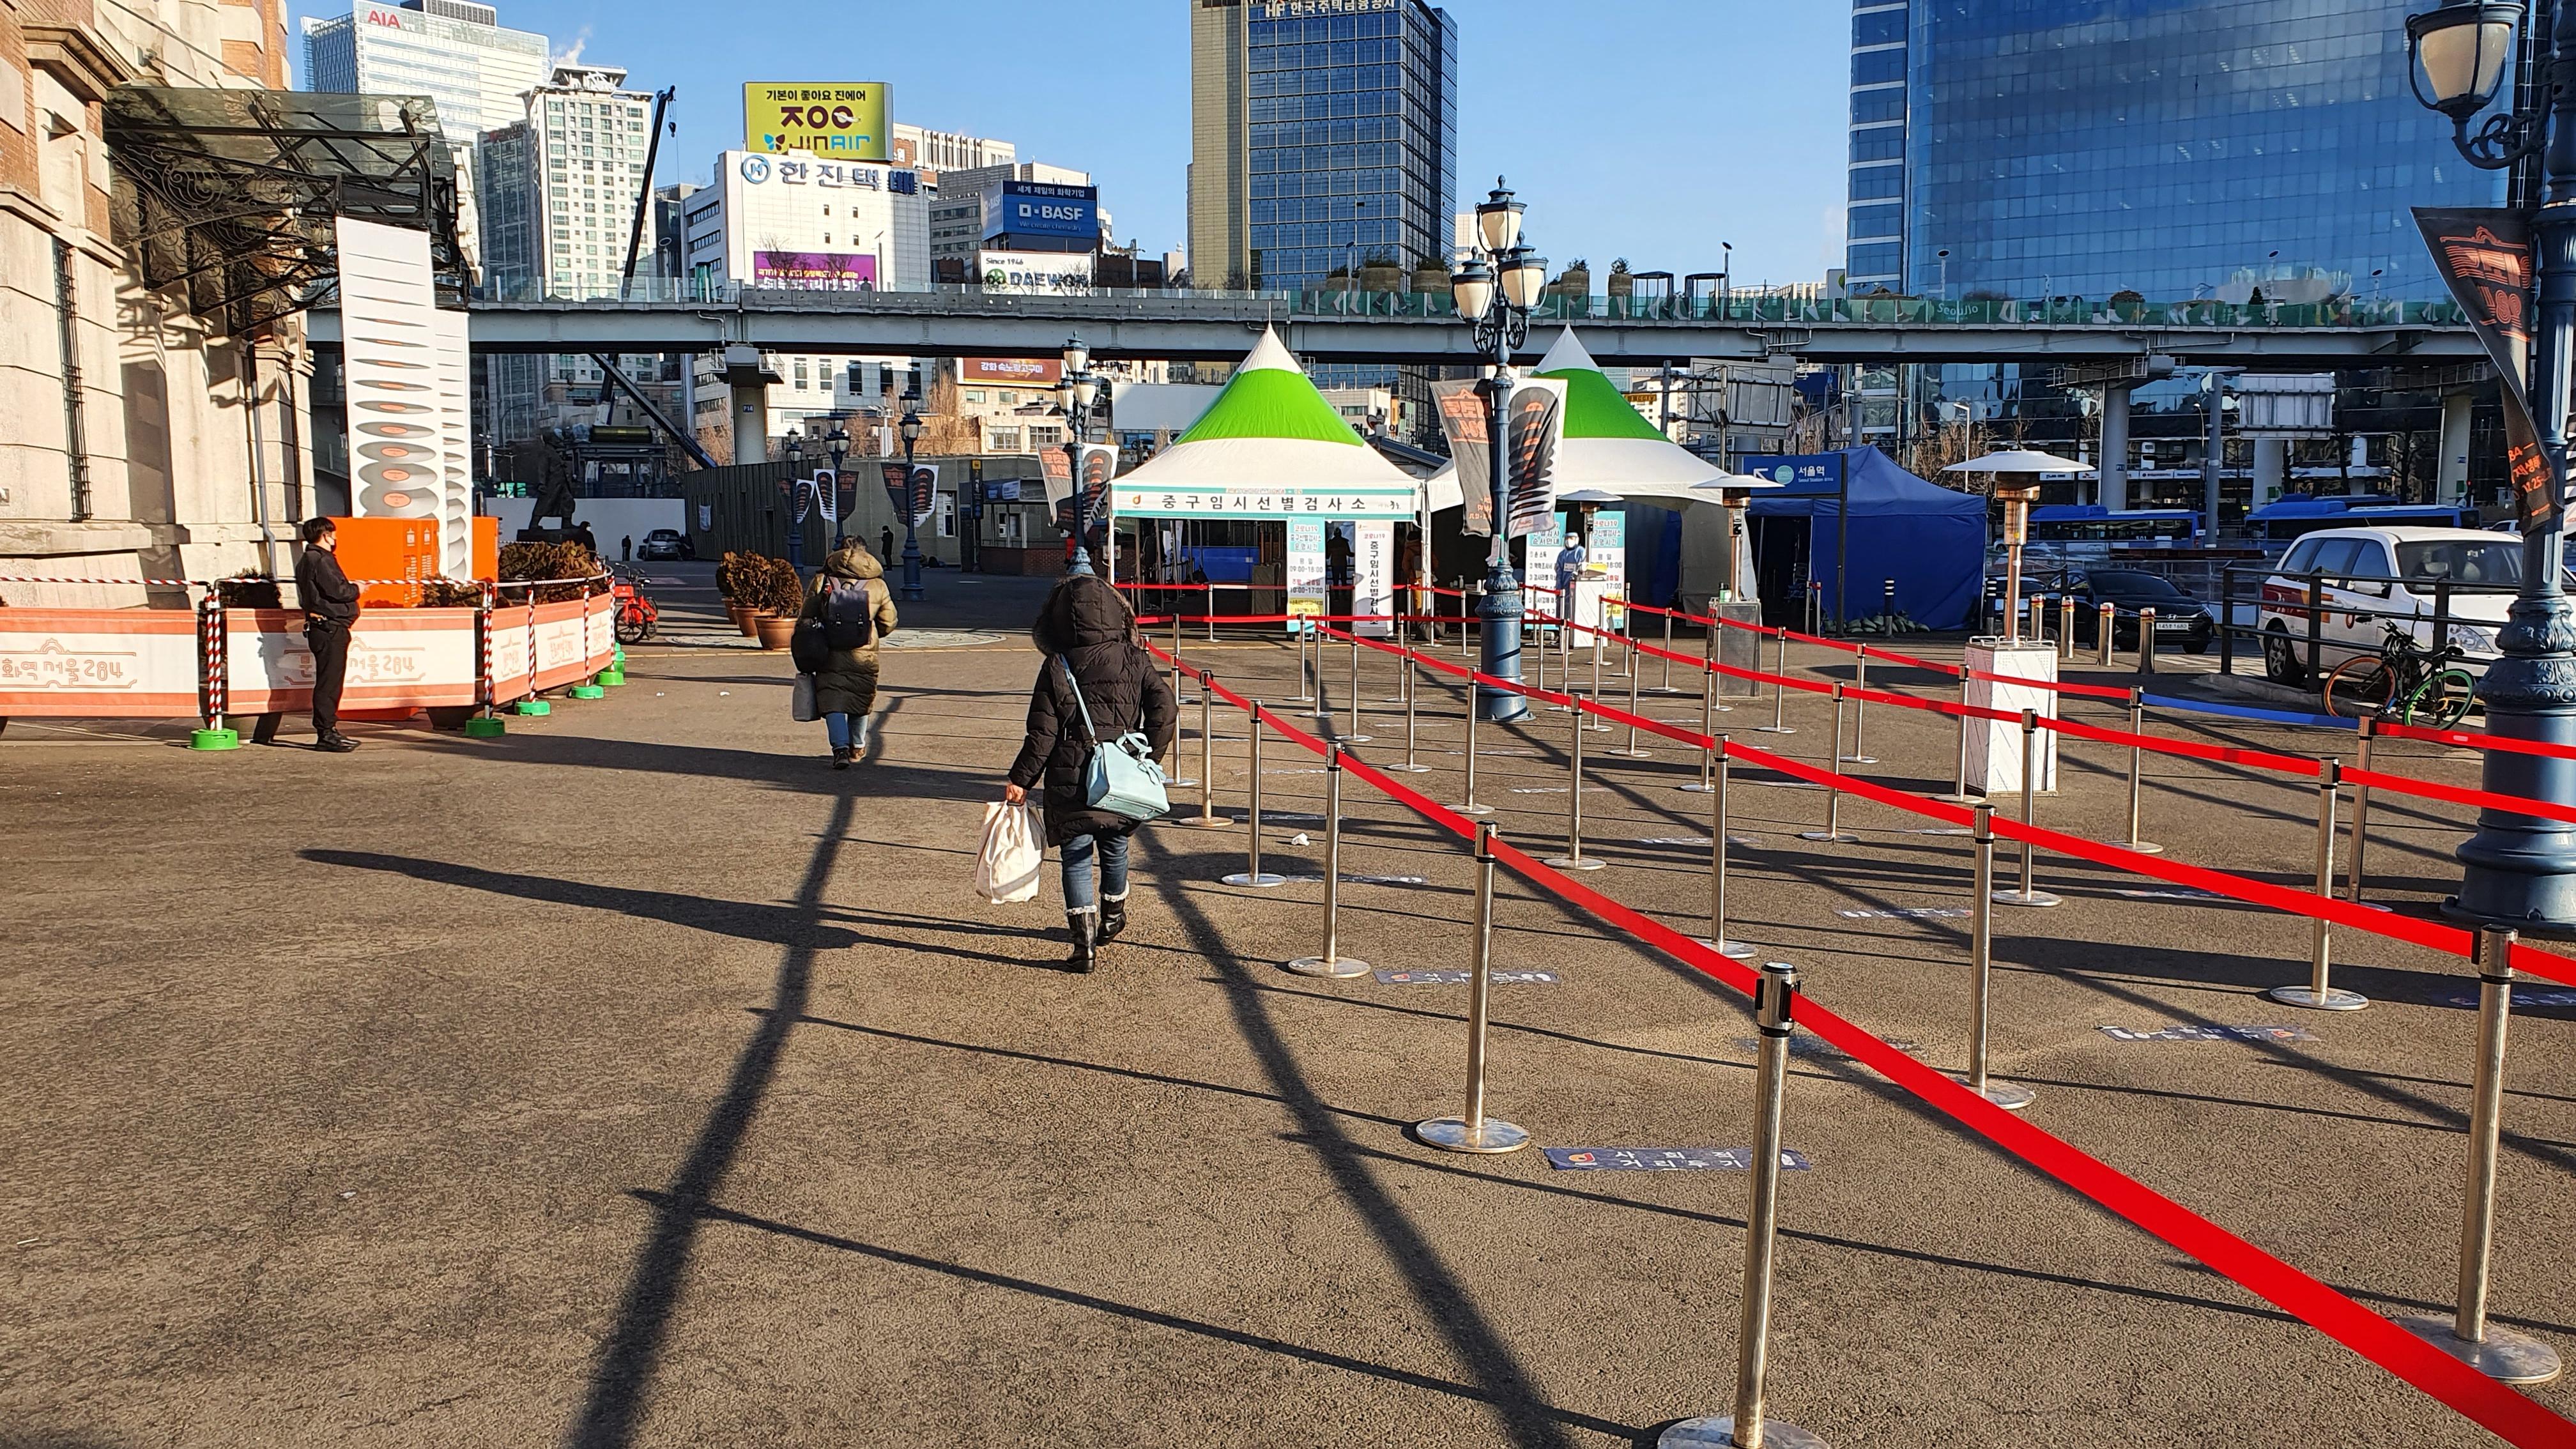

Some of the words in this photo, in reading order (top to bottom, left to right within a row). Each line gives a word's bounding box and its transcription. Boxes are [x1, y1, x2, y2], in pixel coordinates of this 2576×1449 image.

[368, 10, 401, 29] AIA
[767, 90, 797, 101] 기본이
[801, 90, 832, 101] 좋아요
[835, 90, 866, 101] 진에어
[779, 161, 918, 195] 한진택배
[1017, 185, 1031, 194] 세계
[1034, 187, 1054, 195] 제일의
[1057, 188, 1085, 197] 화학기업
[1042, 205, 1084, 221] BASF
[981, 362, 997, 371] 강화
[999, 363, 1043, 374] 속노랑고구마
[1798, 466, 1825, 477] 서울역
[1162, 494, 1366, 512] 중구임시선별검사소
